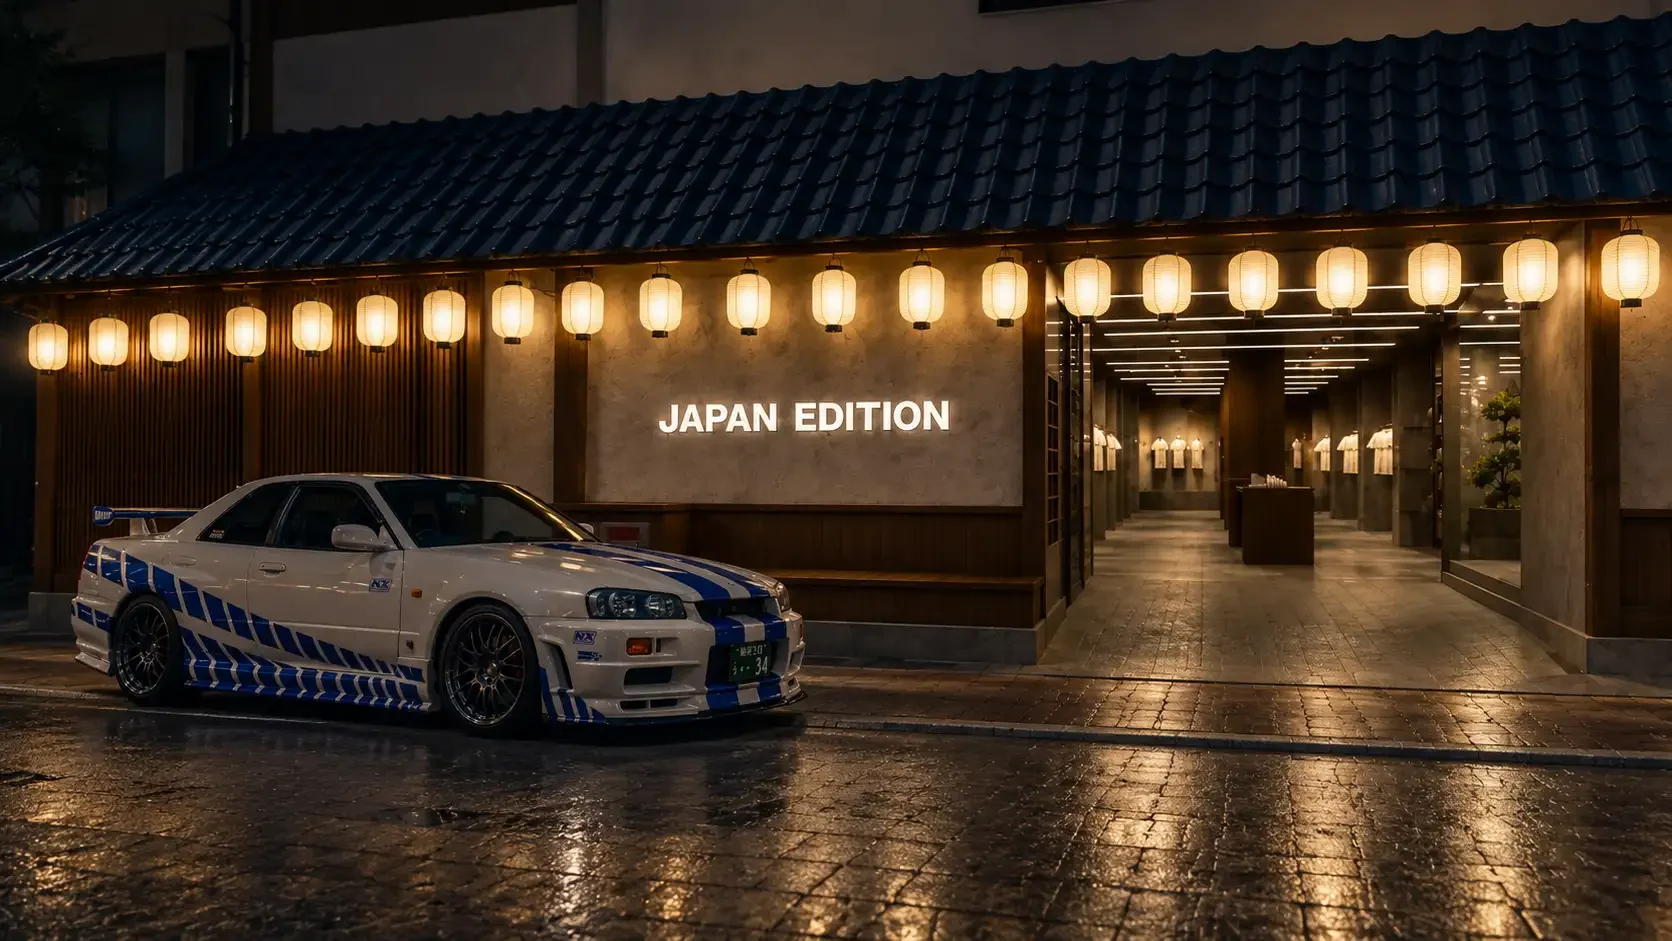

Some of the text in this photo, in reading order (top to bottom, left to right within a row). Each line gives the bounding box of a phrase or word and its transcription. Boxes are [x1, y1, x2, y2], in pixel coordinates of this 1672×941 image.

[658, 400, 950, 433] JAPAN EDITION
[755, 656, 768, 675] 34
